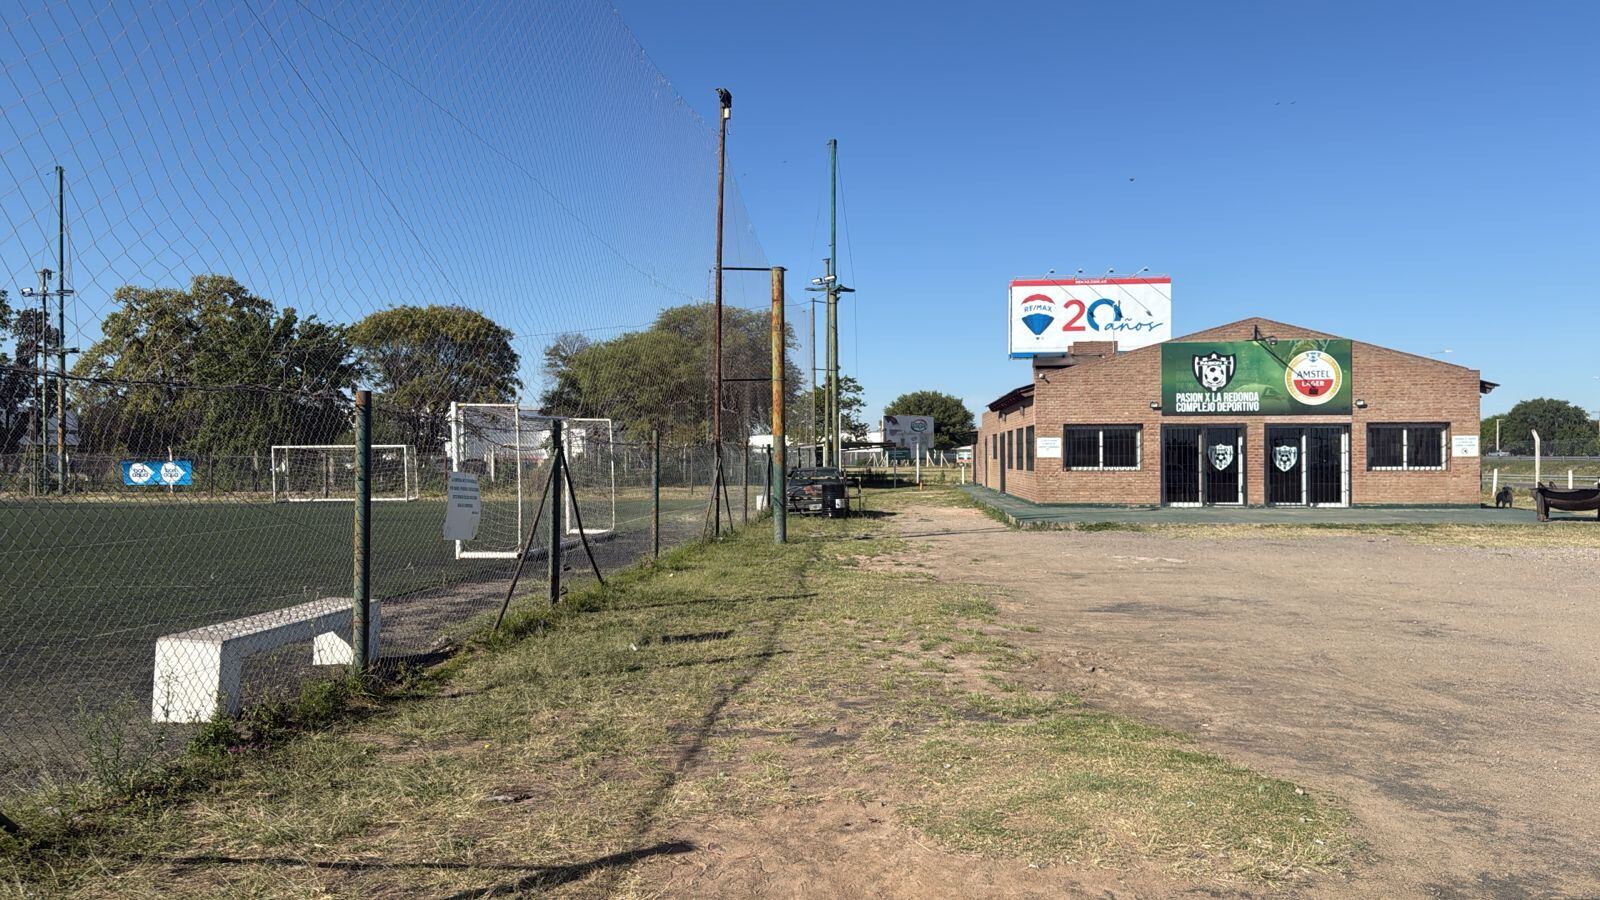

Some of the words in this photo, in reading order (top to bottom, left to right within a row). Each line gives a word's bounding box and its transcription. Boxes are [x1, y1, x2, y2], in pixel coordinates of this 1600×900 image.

[1024, 305, 1053, 313] RE/MAX
[1062, 298, 1122, 332] 20
[1104, 317, 1164, 331] años
[1296, 370, 1330, 378] AMSTEL
[1176, 392, 1203, 403] PASION
[1205, 392, 1210, 402] X
[1212, 392, 1222, 402] LA
[1223, 392, 1259, 402] REDONDA
[1176, 402, 1216, 412] COMPLEJO
[1217, 402, 1259, 411] DEPORTIVO
